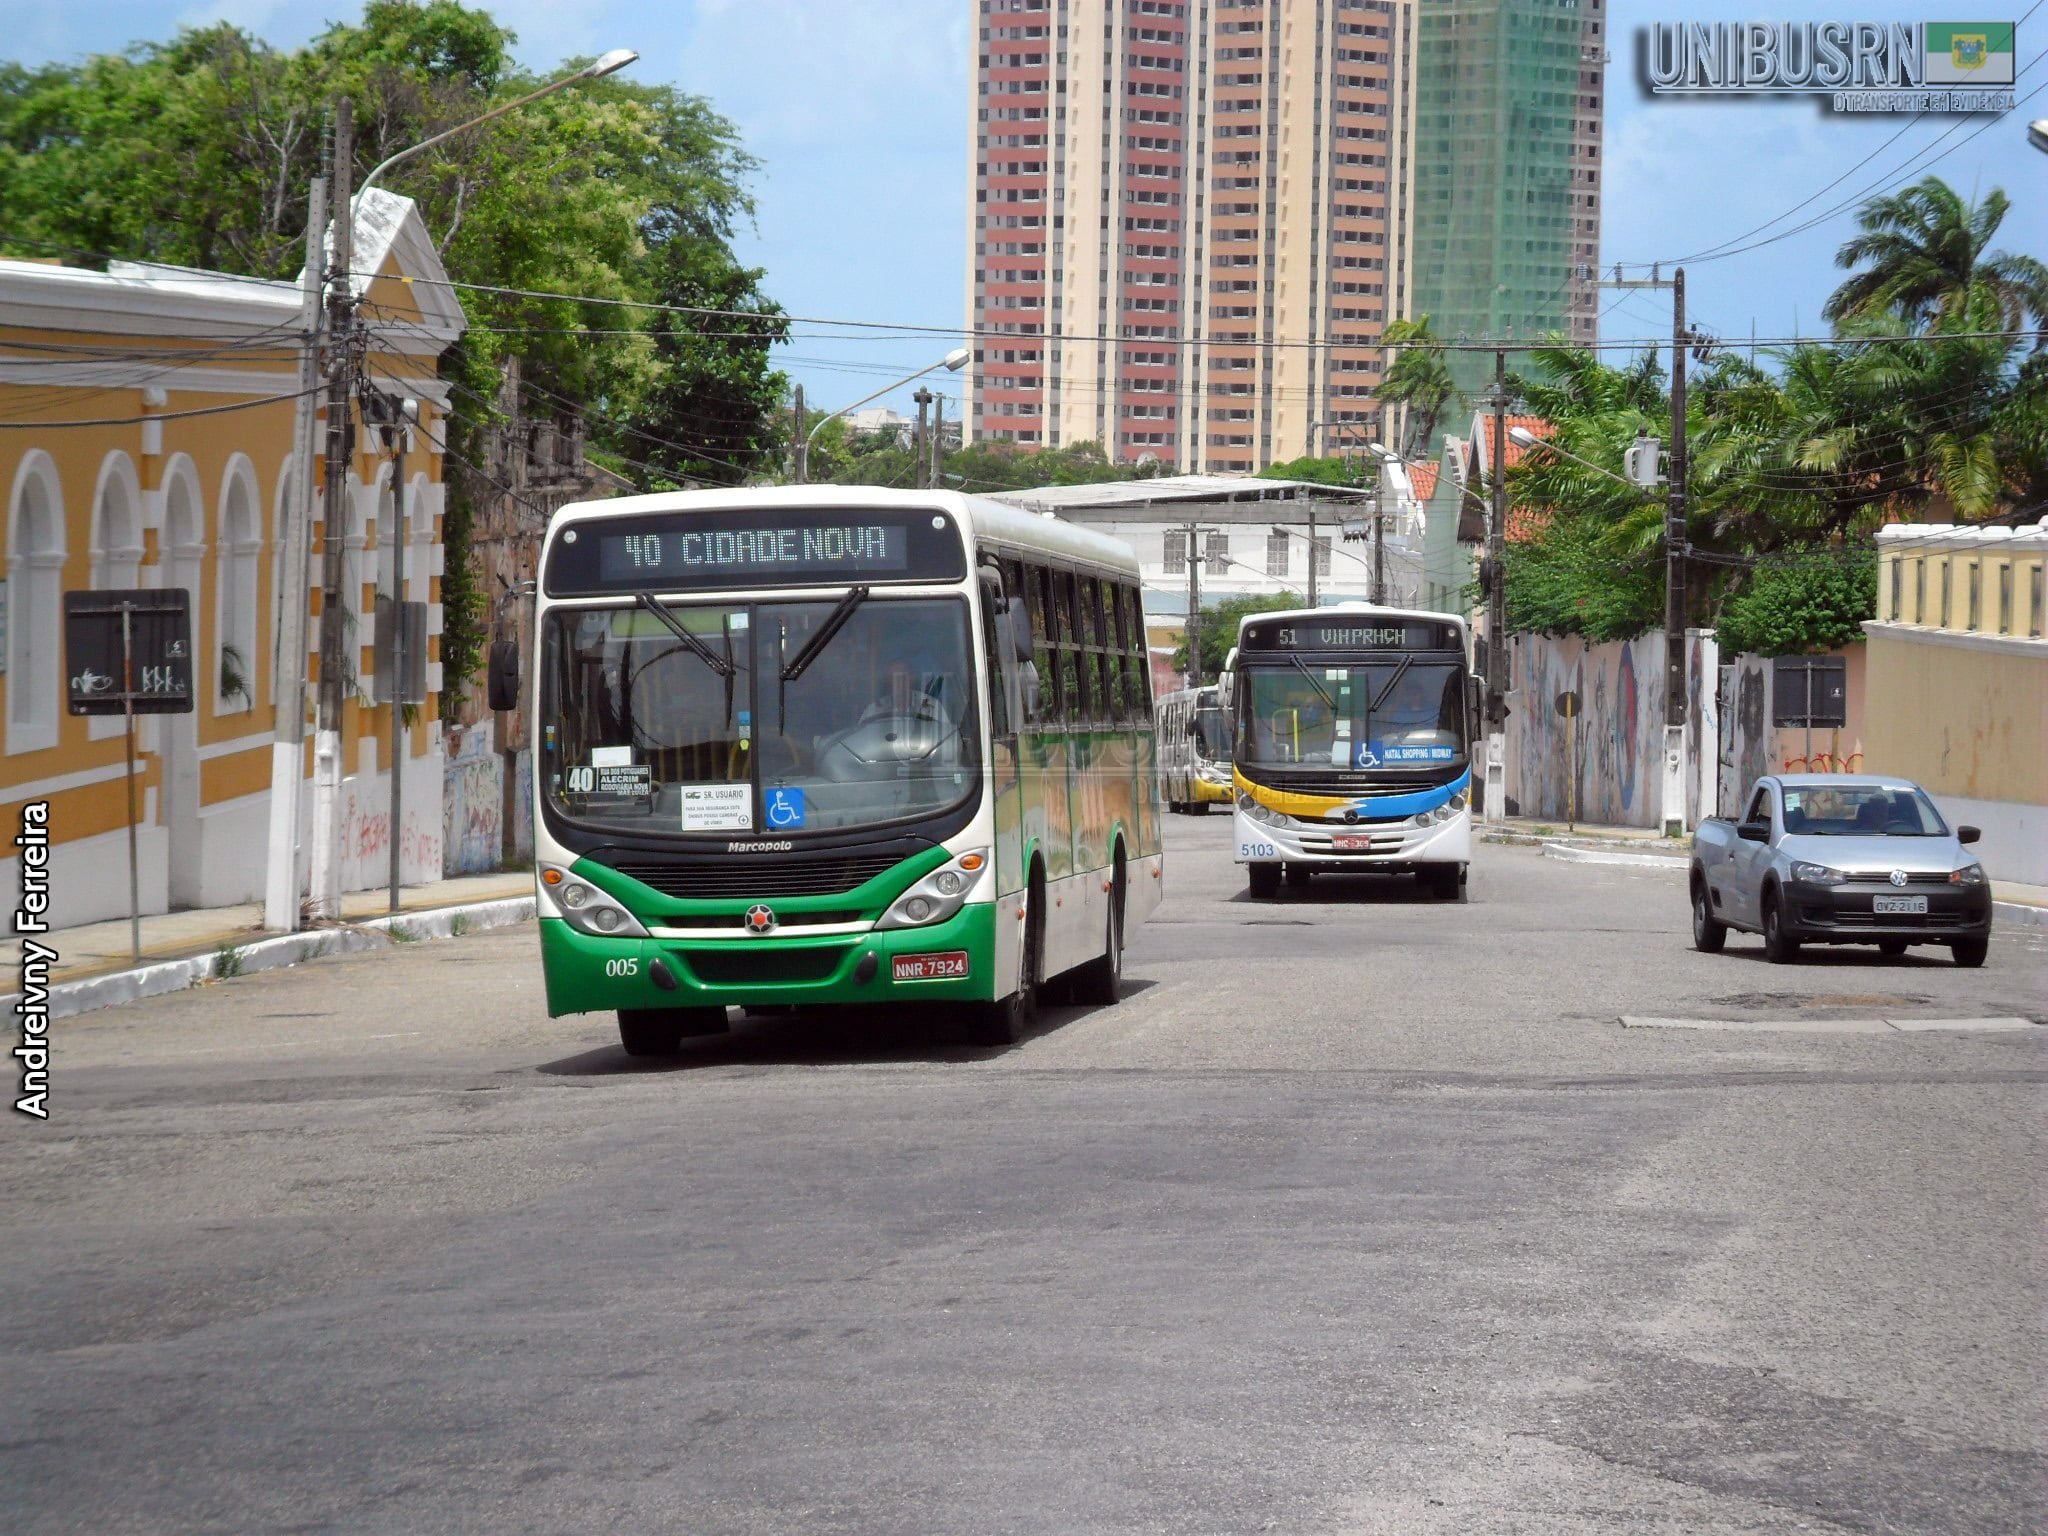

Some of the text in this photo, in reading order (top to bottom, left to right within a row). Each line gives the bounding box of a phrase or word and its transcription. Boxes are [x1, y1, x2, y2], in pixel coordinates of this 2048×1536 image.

[624, 526, 886, 567] 40 CIDADE NOVA
[1280, 629, 1298, 645] 51
[1384, 749, 1401, 760] NATAL
[1402, 748, 1429, 759] SHOPPING
[568, 767, 593, 792] 40
[600, 775, 639, 783] ALECRIM
[703, 791, 714, 799] SR.
[727, 840, 792, 853] Marcopolo
[1241, 843, 1275, 857] 5103
[605, 958, 639, 977] 005
[895, 959, 964, 978] NNR-7924
